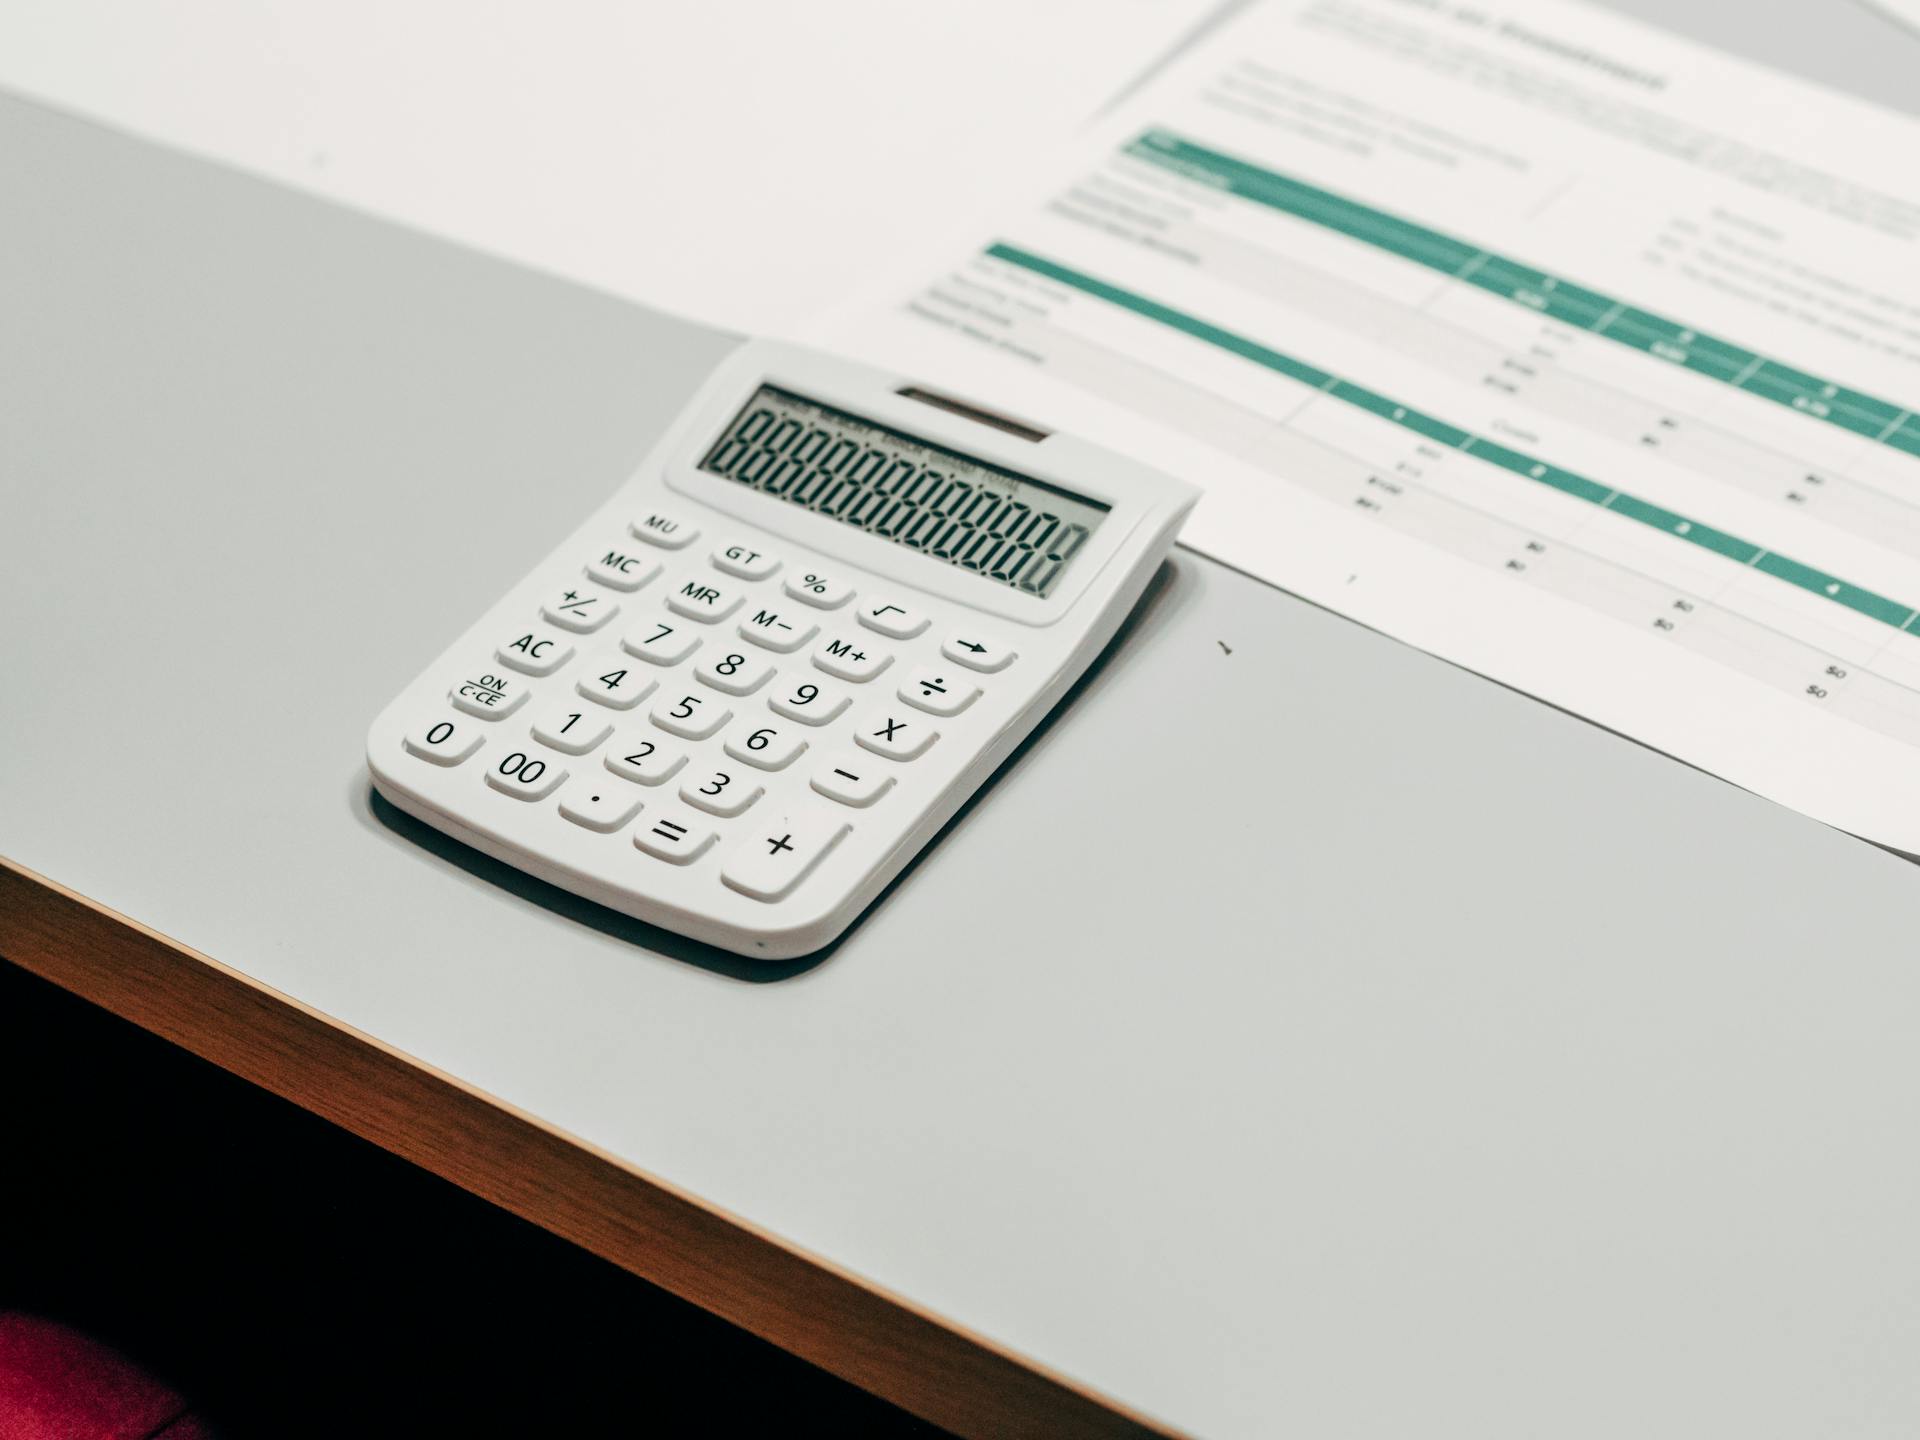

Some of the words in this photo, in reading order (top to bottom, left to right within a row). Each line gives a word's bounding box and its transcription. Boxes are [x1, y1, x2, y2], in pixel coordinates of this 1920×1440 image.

[644, 515, 679, 534] MU
[600, 551, 640, 574] MC
[726, 546, 762, 566] GT
[681, 582, 720, 605] MR
[804, 573, 826, 594] %
[644, 624, 674, 644] 7
[509, 634, 554, 658] AC
[826, 639, 867, 662] M+
[715, 654, 745, 676] 8
[1826, 665, 1847, 679] $0
[479, 674, 508, 692] ON
[599, 670, 628, 690] 4
[788, 684, 819, 705] 9
[1806, 685, 1828, 698] $0
[669, 696, 702, 719] 5
[426, 722, 455, 745] 0
[560, 713, 582, 734] 1
[746, 728, 777, 751] 6
[624, 741, 655, 766] 2
[498, 752, 546, 784] 00
[699, 772, 731, 795] 3
